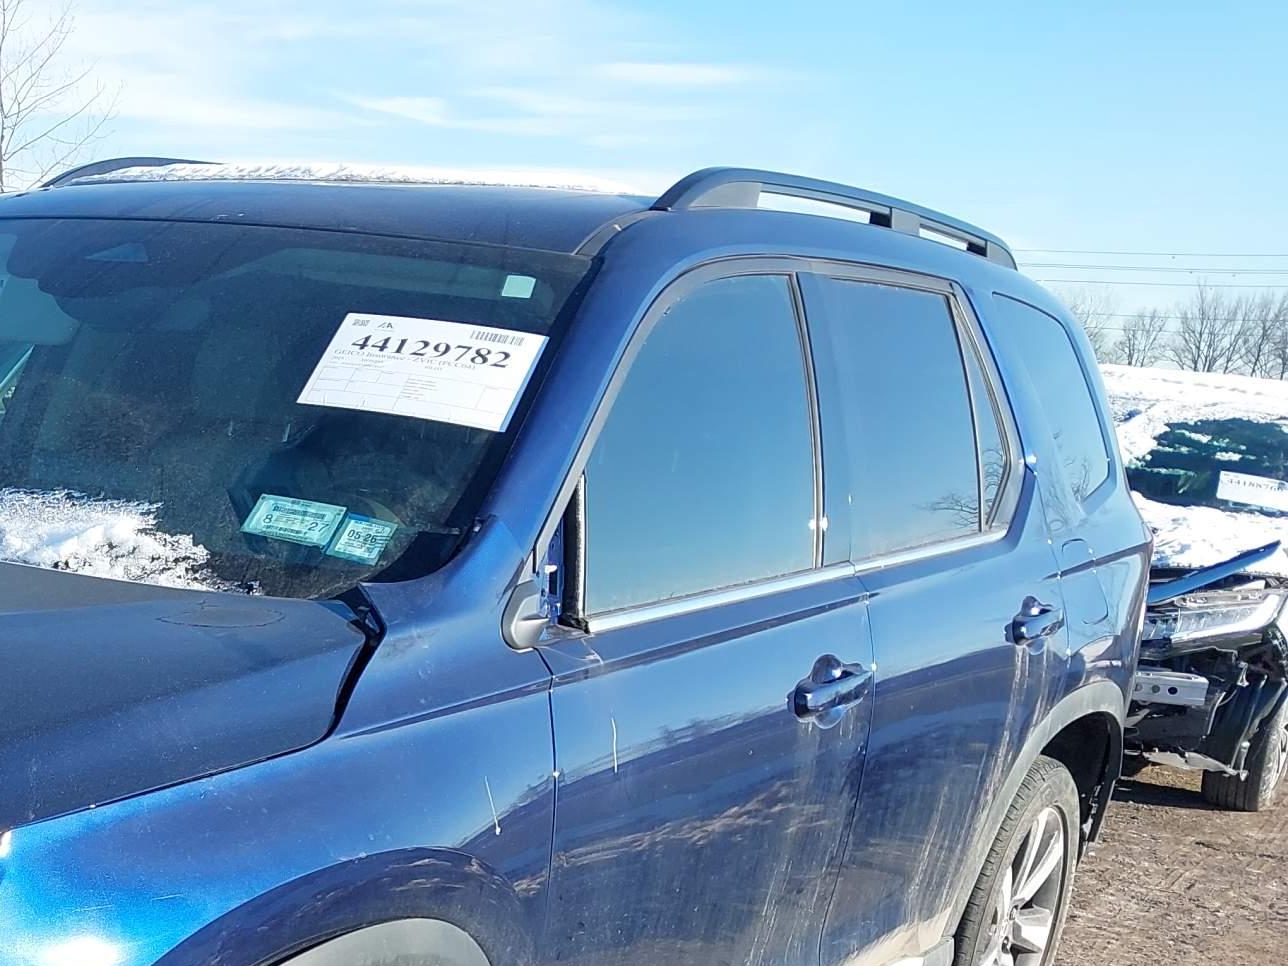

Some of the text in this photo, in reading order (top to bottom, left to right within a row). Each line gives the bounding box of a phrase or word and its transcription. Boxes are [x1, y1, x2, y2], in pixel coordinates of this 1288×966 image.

[351, 333, 512, 369] 44129782
[262, 513, 274, 524] 8
[307, 521, 329, 533] 27
[347, 529, 362, 540] 05
